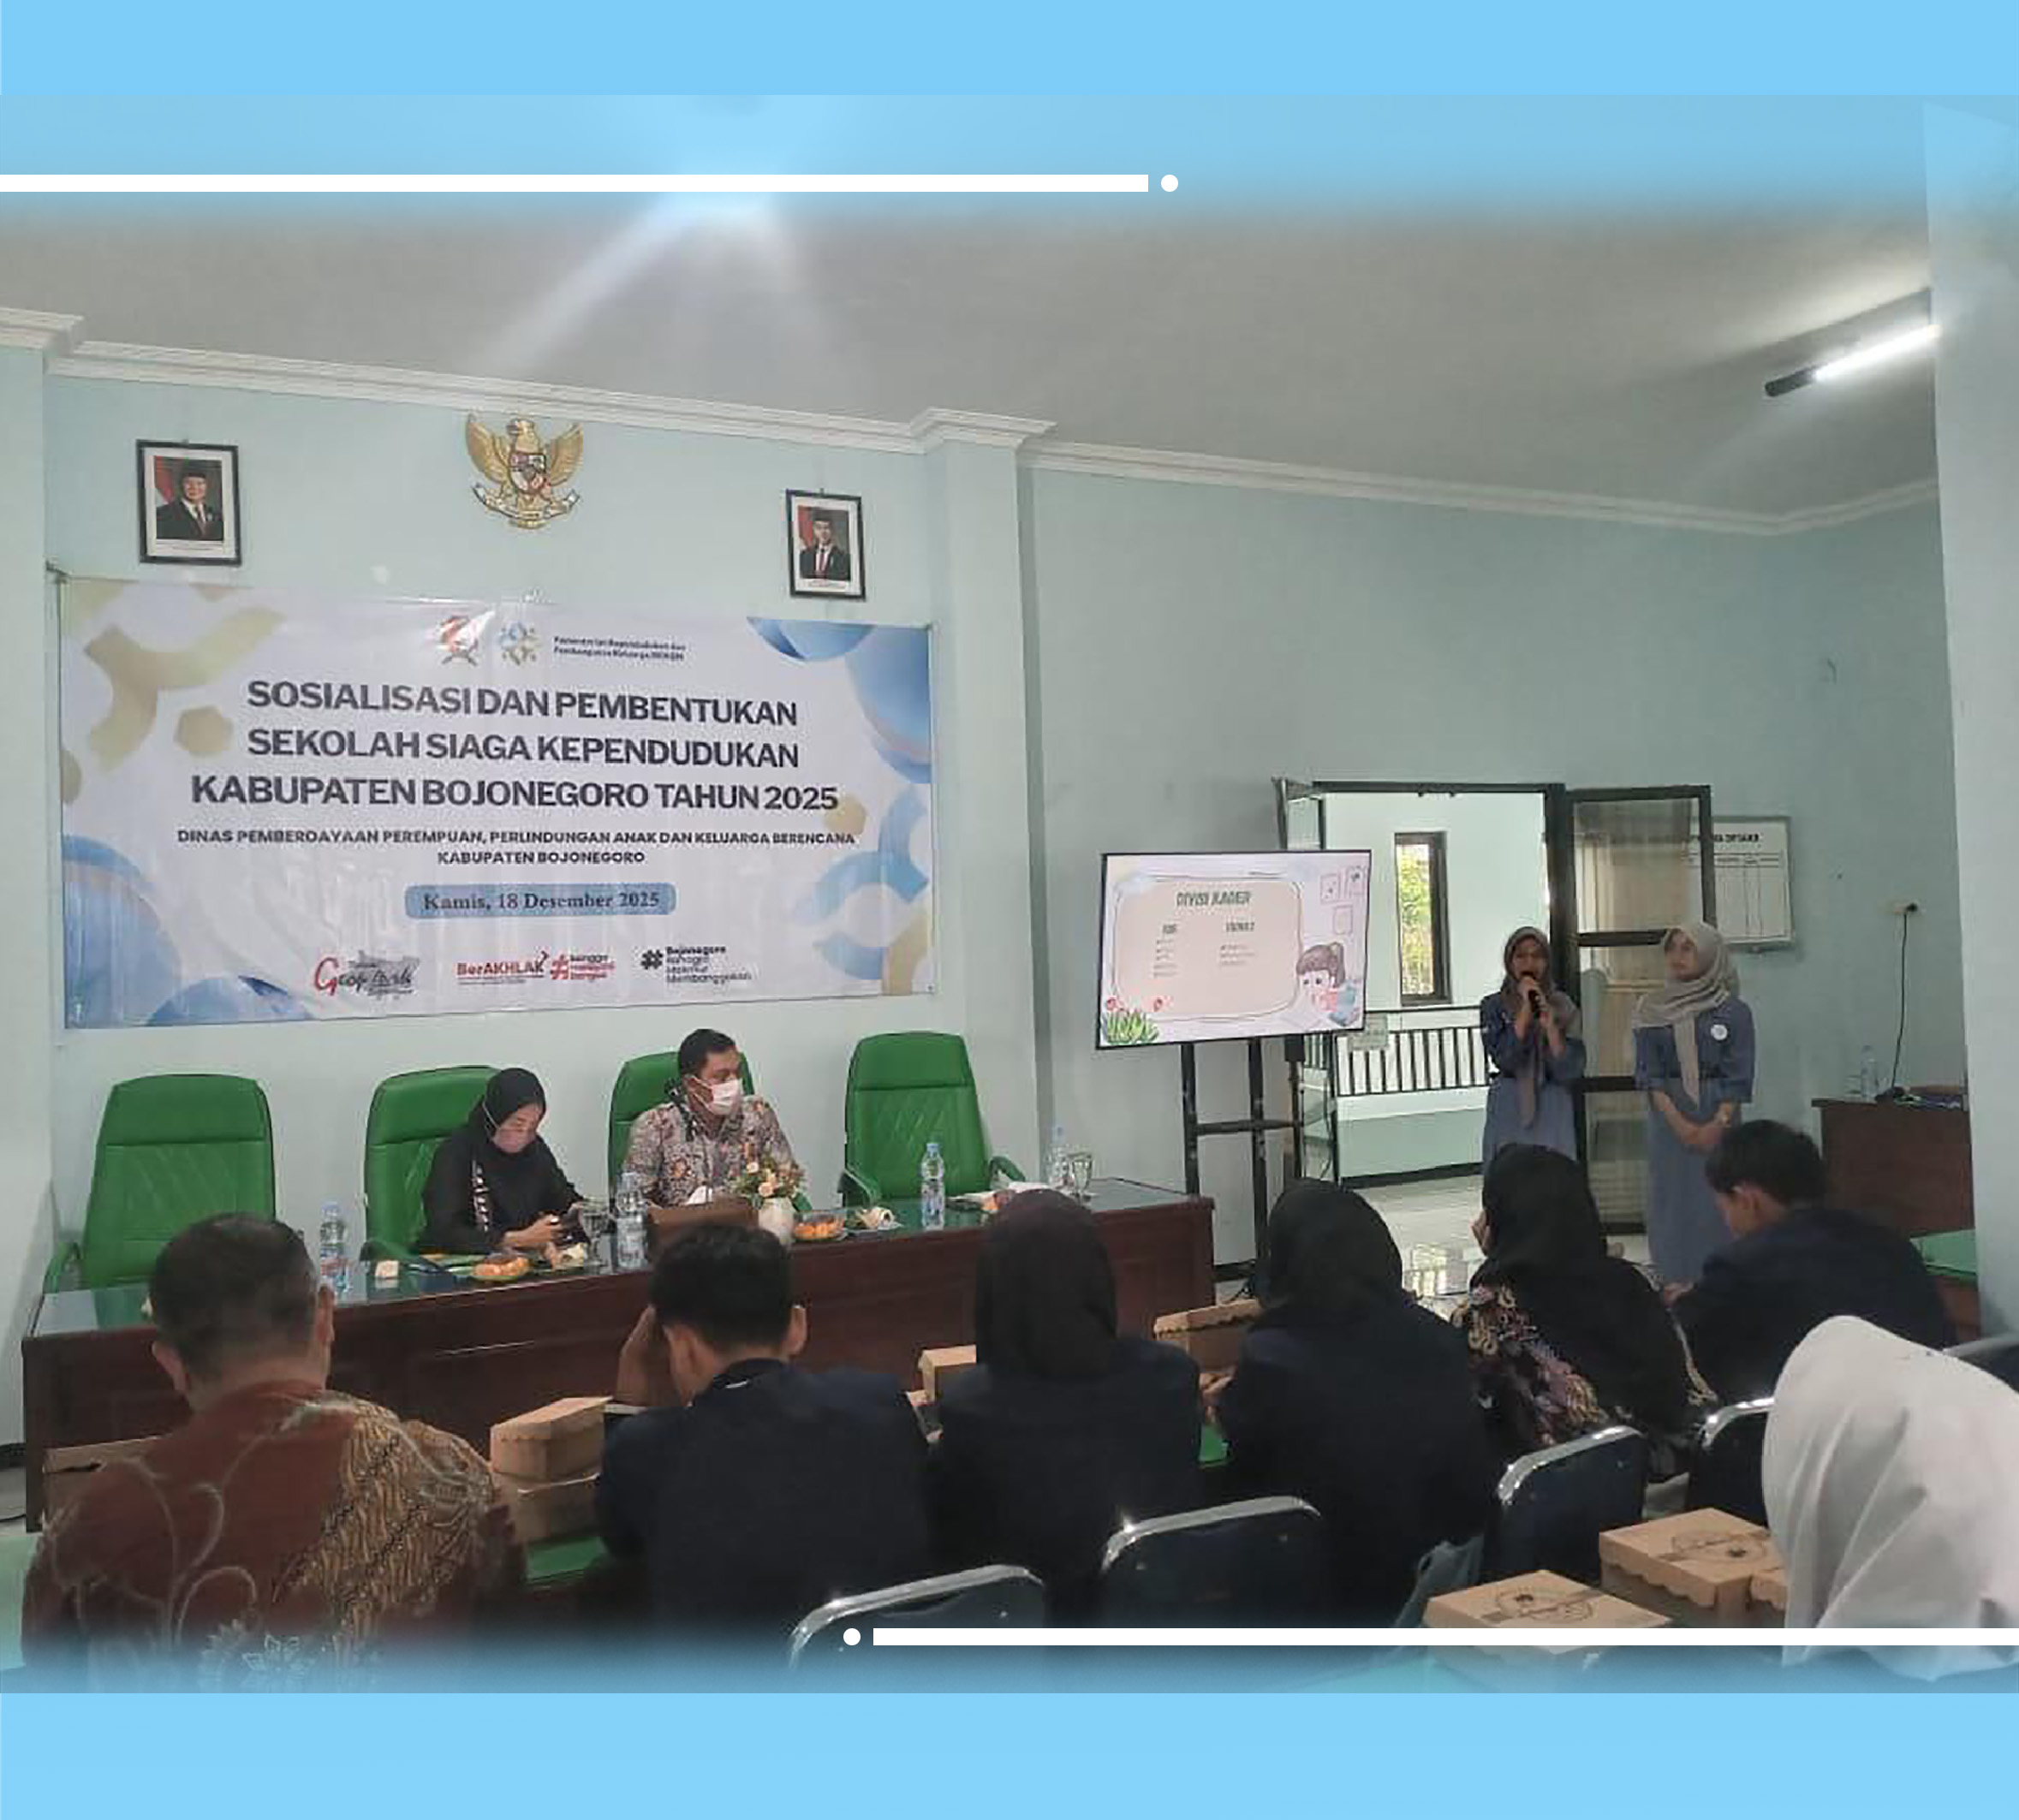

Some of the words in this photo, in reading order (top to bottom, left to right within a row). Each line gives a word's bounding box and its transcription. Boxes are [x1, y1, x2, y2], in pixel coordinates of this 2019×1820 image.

[247, 681, 470, 714] SOSIALISASI
[477, 688, 549, 716] DAN
[555, 692, 797, 726] PEMBENTUKAN
[247, 728, 420, 758] SEKOLAH
[426, 733, 533, 760] SIAGA
[537, 736, 799, 768] KEPENDUDUKAN
[191, 775, 415, 805] KABUPATEN
[422, 779, 648, 807] BOJONEGORO
[653, 782, 759, 809] TAHUN
[763, 786, 839, 810] 2025
[177, 830, 233, 842] DINAS
[236, 830, 378, 842] PEMBERDAYAAN
[383, 830, 486, 844] PEREMPUAN,
[490, 830, 610, 844] PERLINDUNGAN
[612, 830, 657, 844] ANAK
[658, 832, 692, 844] DAN
[694, 832, 771, 844] KELUARGA
[772, 833, 855, 845] BERENCANA
[438, 852, 535, 865] KABUPATEN
[538, 851, 645, 865] BOJONEGORO
[424, 892, 491, 911] Kamis,
[498, 892, 518, 909] 18
[524, 891, 613, 910] Desember
[619, 892, 660, 908] 2025
